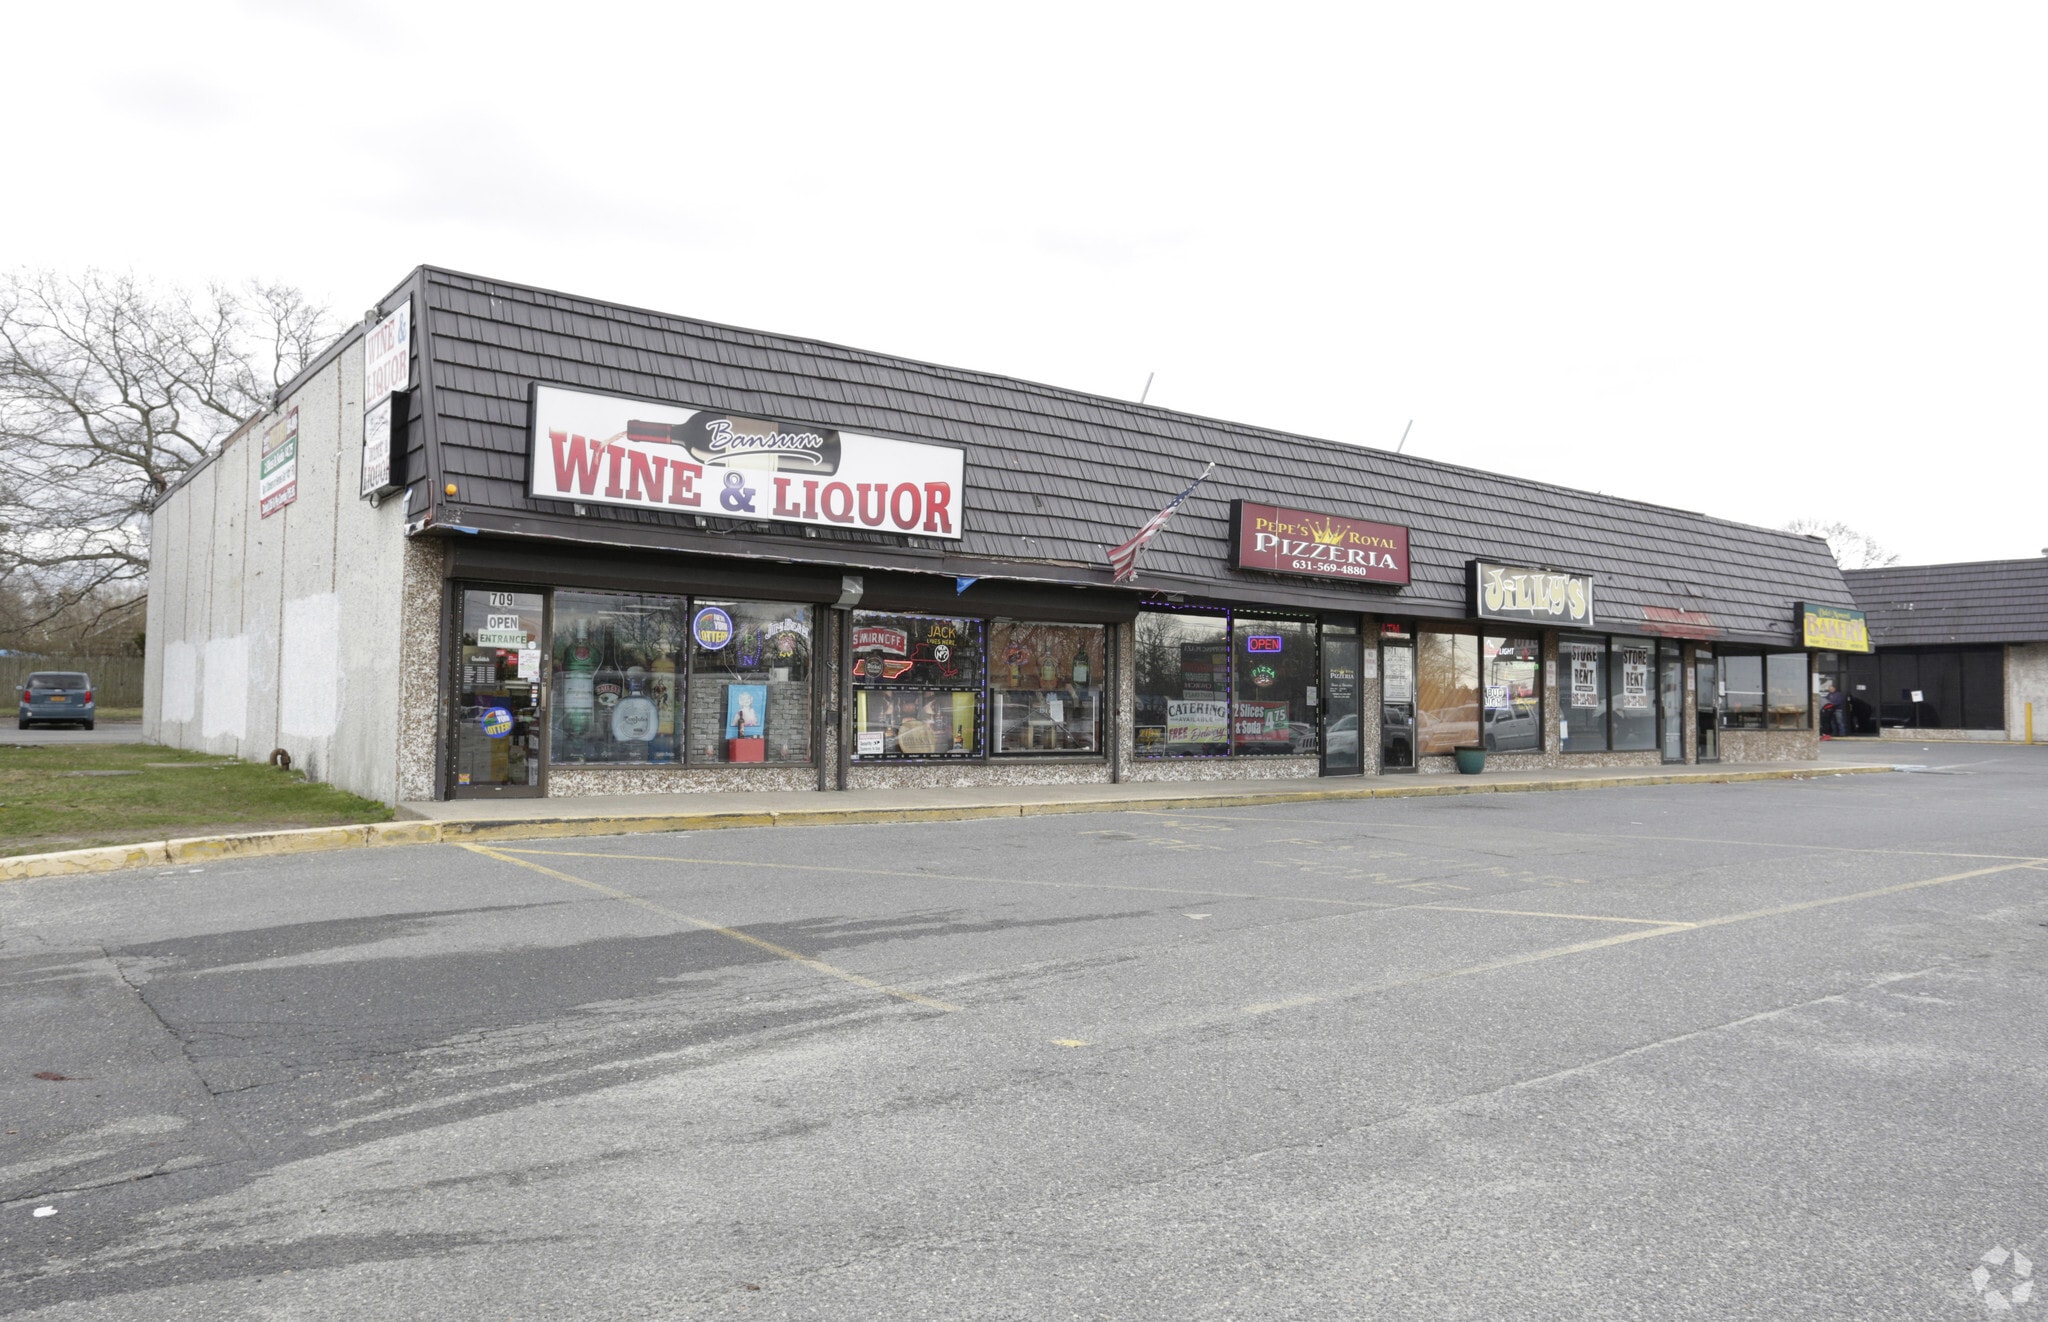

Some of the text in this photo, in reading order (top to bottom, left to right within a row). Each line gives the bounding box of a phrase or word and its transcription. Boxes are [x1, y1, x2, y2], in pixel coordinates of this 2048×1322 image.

[367, 312, 407, 365] WINE &
[367, 349, 407, 404] LIQUOR
[704, 419, 822, 450] Bansum
[549, 427, 953, 534] WINE & LIQUOR
[1254, 532, 1399, 570] PIZZERIA
[1292, 559, 1366, 576] 631-569-4880
[491, 593, 513, 606] 709
[489, 617, 518, 629] OPEN
[1806, 615, 1864, 642] BAKERY
[479, 634, 527, 645] ENTRANCE
[927, 625, 956, 639] JACK
[1250, 638, 1279, 650] OPEN
[1499, 647, 1515, 655] LIGHT
[1572, 645, 1597, 661] STORE
[1623, 649, 1647, 665] STORE
[1252, 666, 1275, 679] PIZZA
[1574, 668, 1594, 685] RENT
[1625, 671, 1644, 687] RENT
[1487, 687, 1504, 698] BUD
[1168, 702, 1226, 718] CATERING
[1234, 703, 1241, 717] 2
[1240, 703, 1264, 718] Slices
[1168, 727, 1189, 740] FREE
[1190, 726, 1227, 743] Delivery
[1241, 719, 1262, 735] Soda
